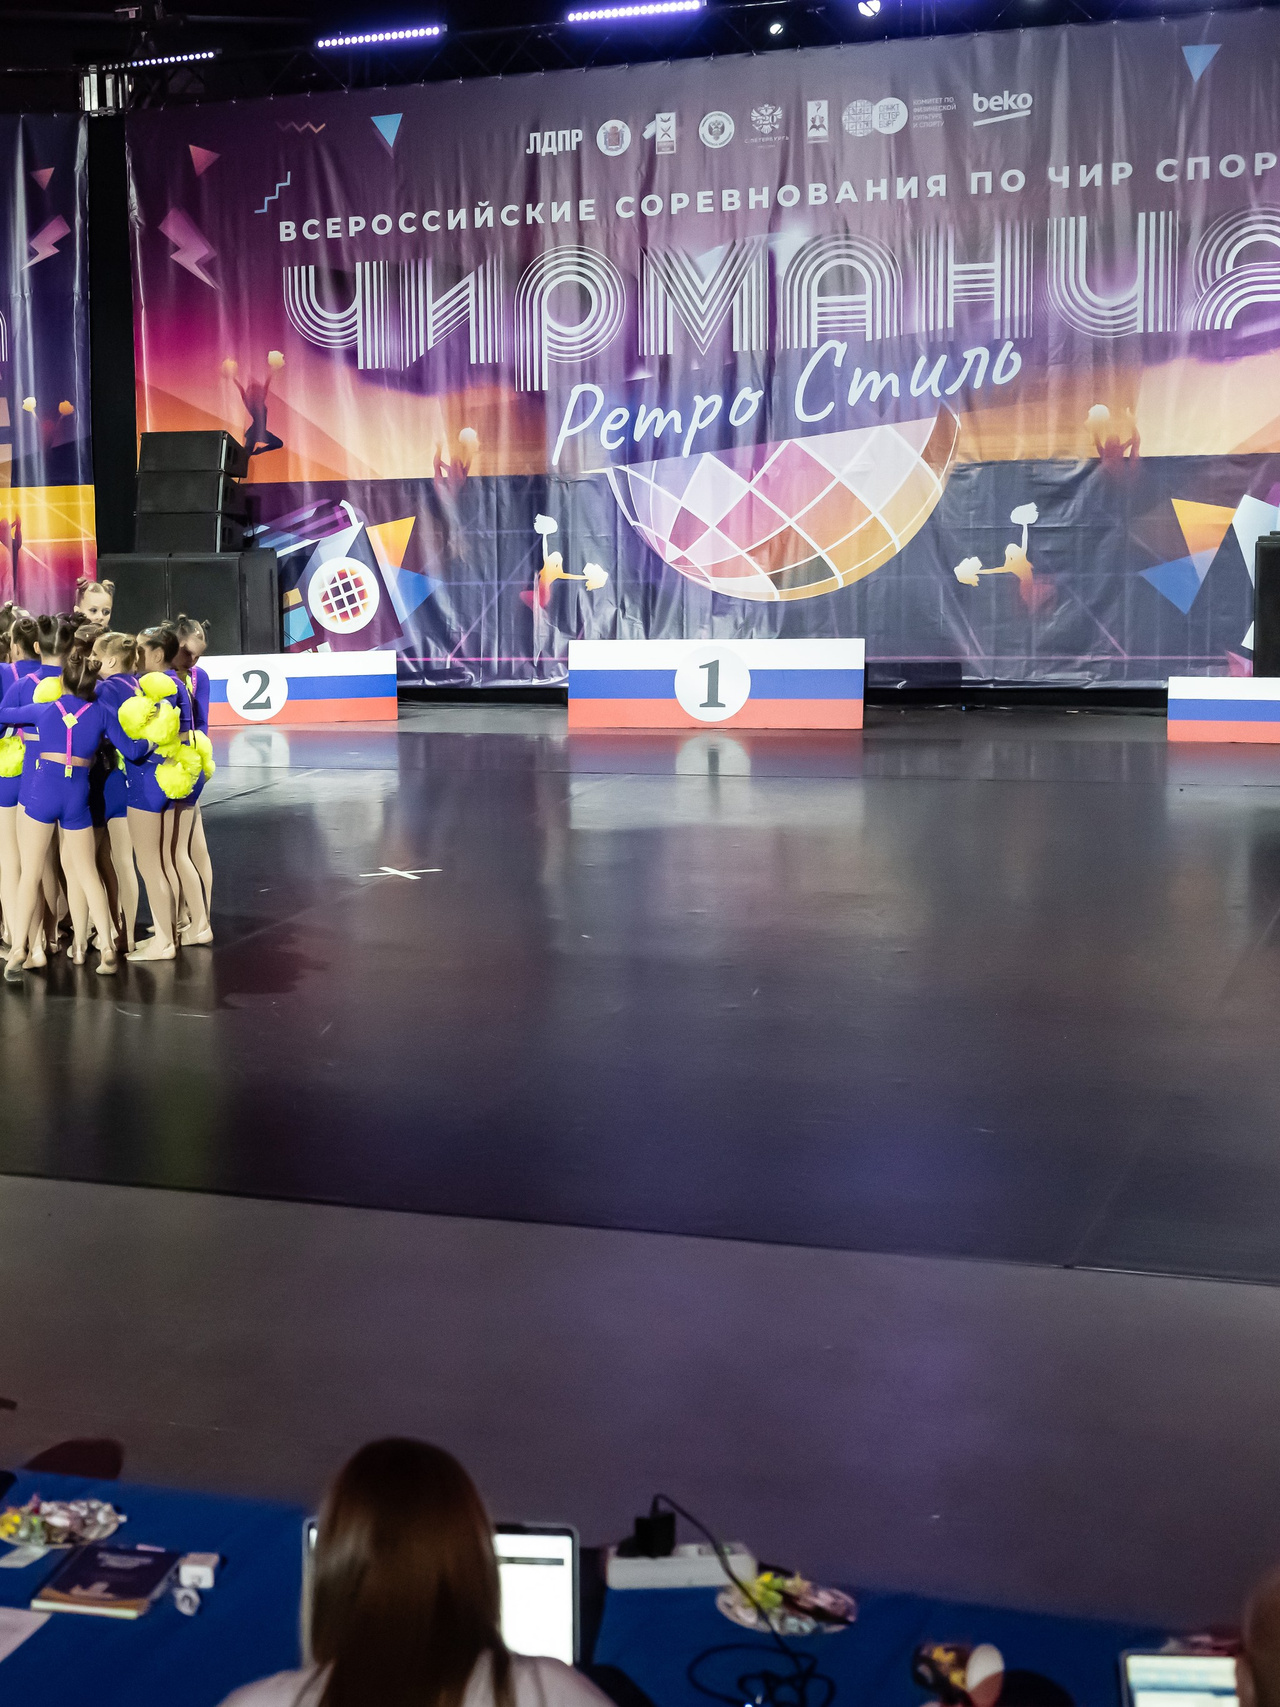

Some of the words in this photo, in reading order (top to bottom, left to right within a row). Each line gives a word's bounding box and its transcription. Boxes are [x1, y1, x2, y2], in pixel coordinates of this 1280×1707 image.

[912, 97, 943, 106] КОМИТЕТ
[912, 102, 957, 113] ФИЗИЧЕСКОЙ
[972, 91, 1033, 113] beko
[525, 128, 583, 157] ЛДПР
[279, 199, 597, 243] ВСЕРОССИЙСКИЕ
[614, 174, 948, 219] СОРЕВНОВАНИЯ
[970, 169, 1027, 195] ПО
[1049, 162, 1133, 189] ЧИР
[551, 382, 761, 466] Ретро
[795, 338, 1023, 423] Стиль
[242, 669, 272, 710] 2
[698, 659, 726, 708] 1
